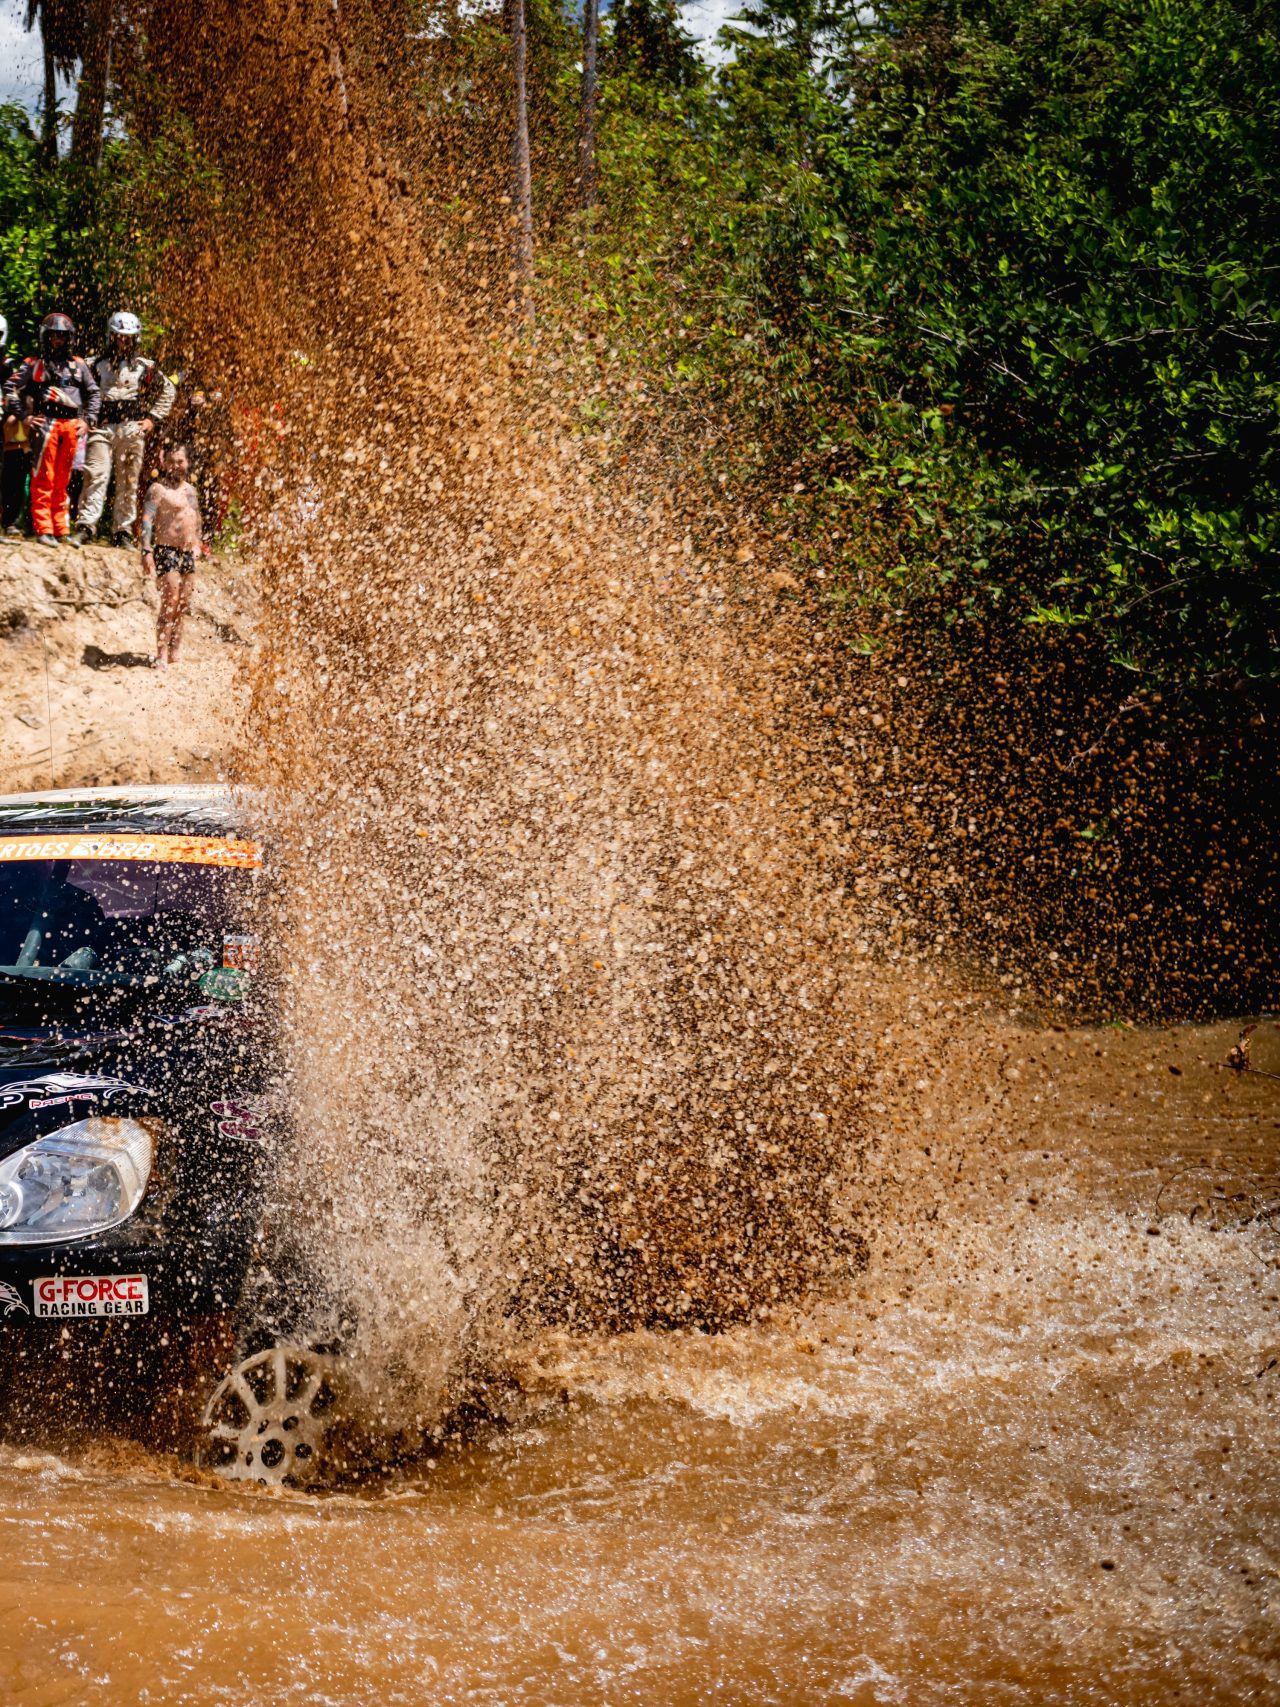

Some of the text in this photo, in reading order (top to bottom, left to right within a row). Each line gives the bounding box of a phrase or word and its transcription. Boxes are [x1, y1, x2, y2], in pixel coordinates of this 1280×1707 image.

[28, 1093, 94, 1110] RACING
[39, 1277, 144, 1302] G-FORCE
[39, 1300, 145, 1316] RACING GEAR
